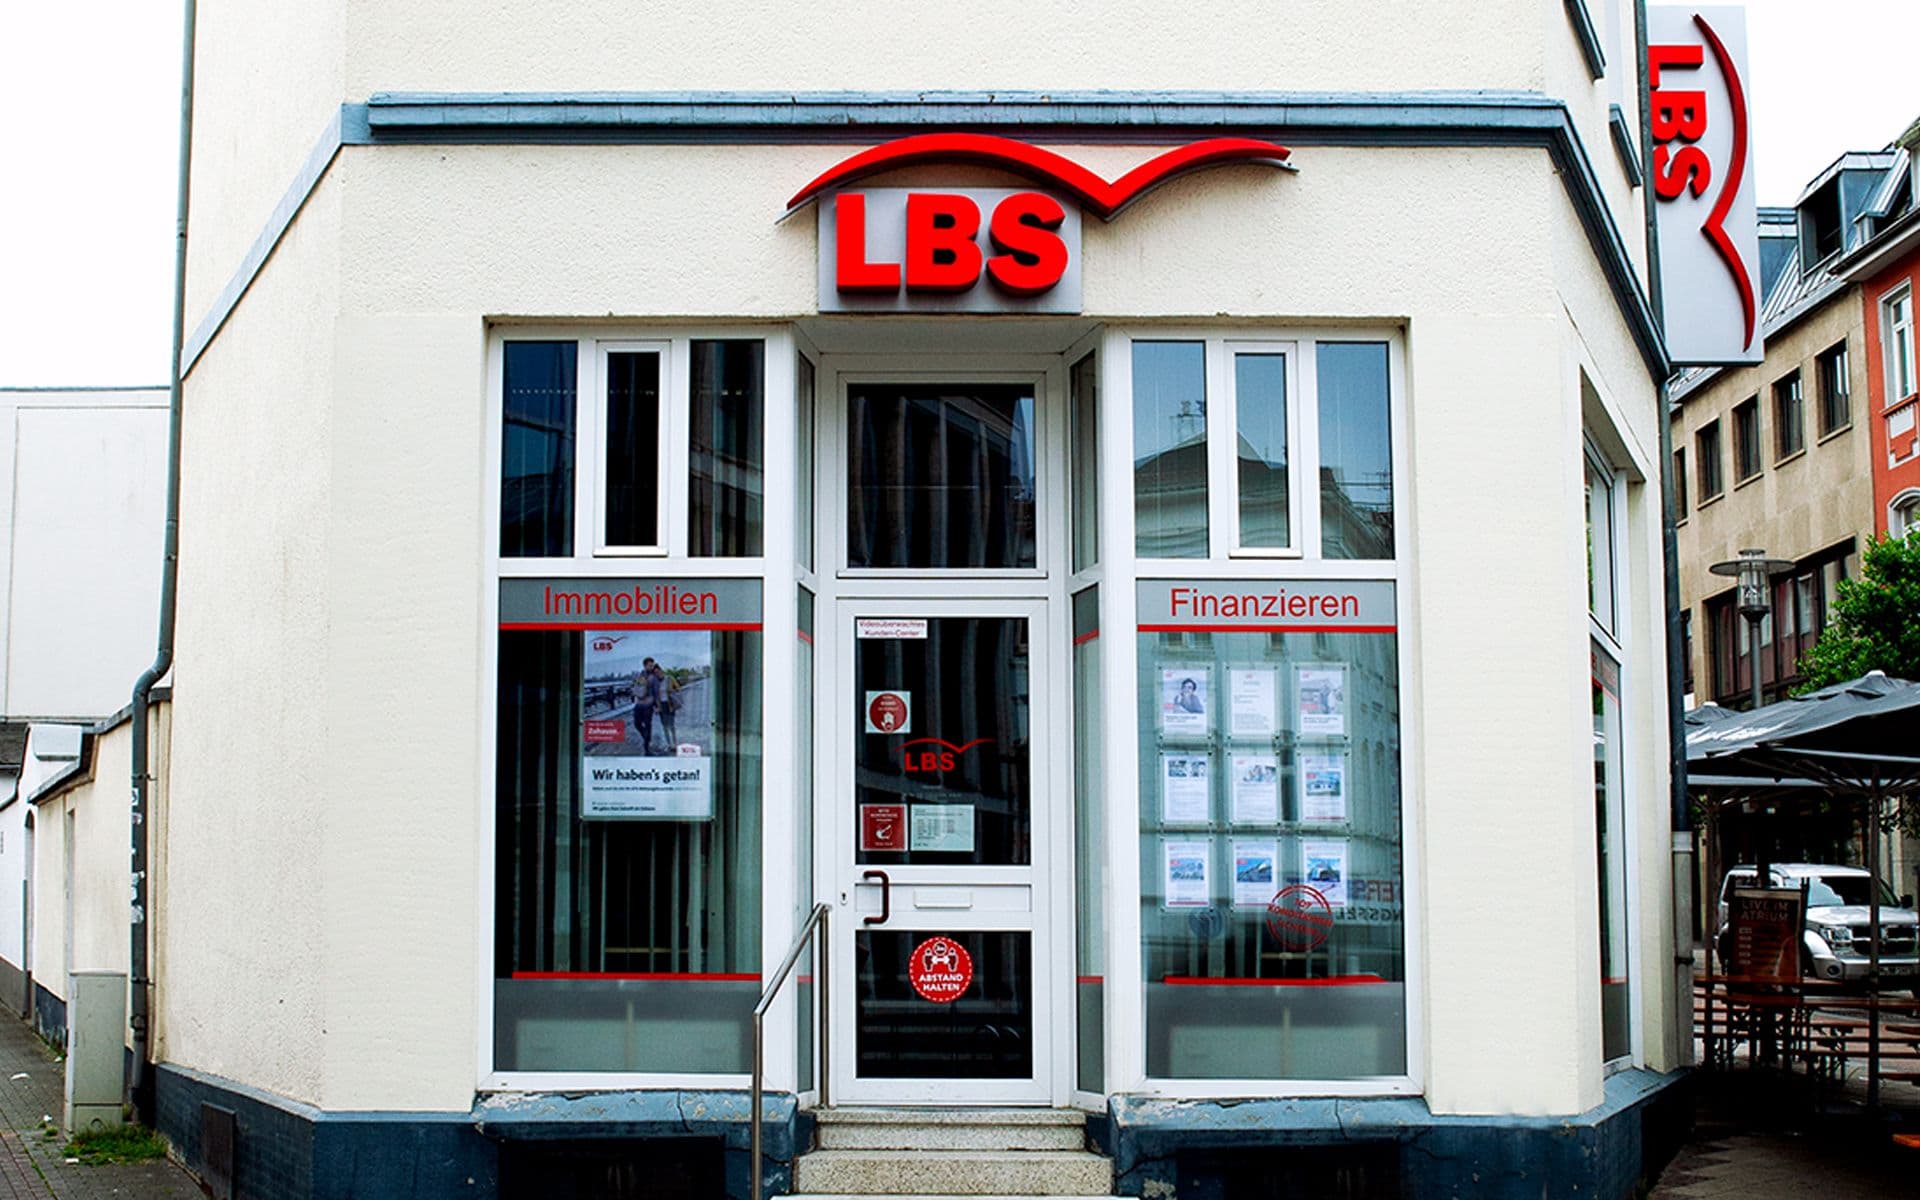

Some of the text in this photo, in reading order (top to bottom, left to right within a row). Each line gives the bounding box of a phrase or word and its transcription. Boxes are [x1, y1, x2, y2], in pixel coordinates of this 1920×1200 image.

[1647, 44, 1712, 200] LBS
[835, 191, 1069, 294] LBS
[544, 585, 718, 615] Immobilien
[1170, 588, 1359, 617] Finanzieren
[593, 641, 613, 652] LBS
[904, 752, 955, 772] LBS
[592, 768, 700, 785] Wir haben's getan!
[918, 973, 964, 983] ABSTAND
[923, 983, 960, 992] HALTEN
